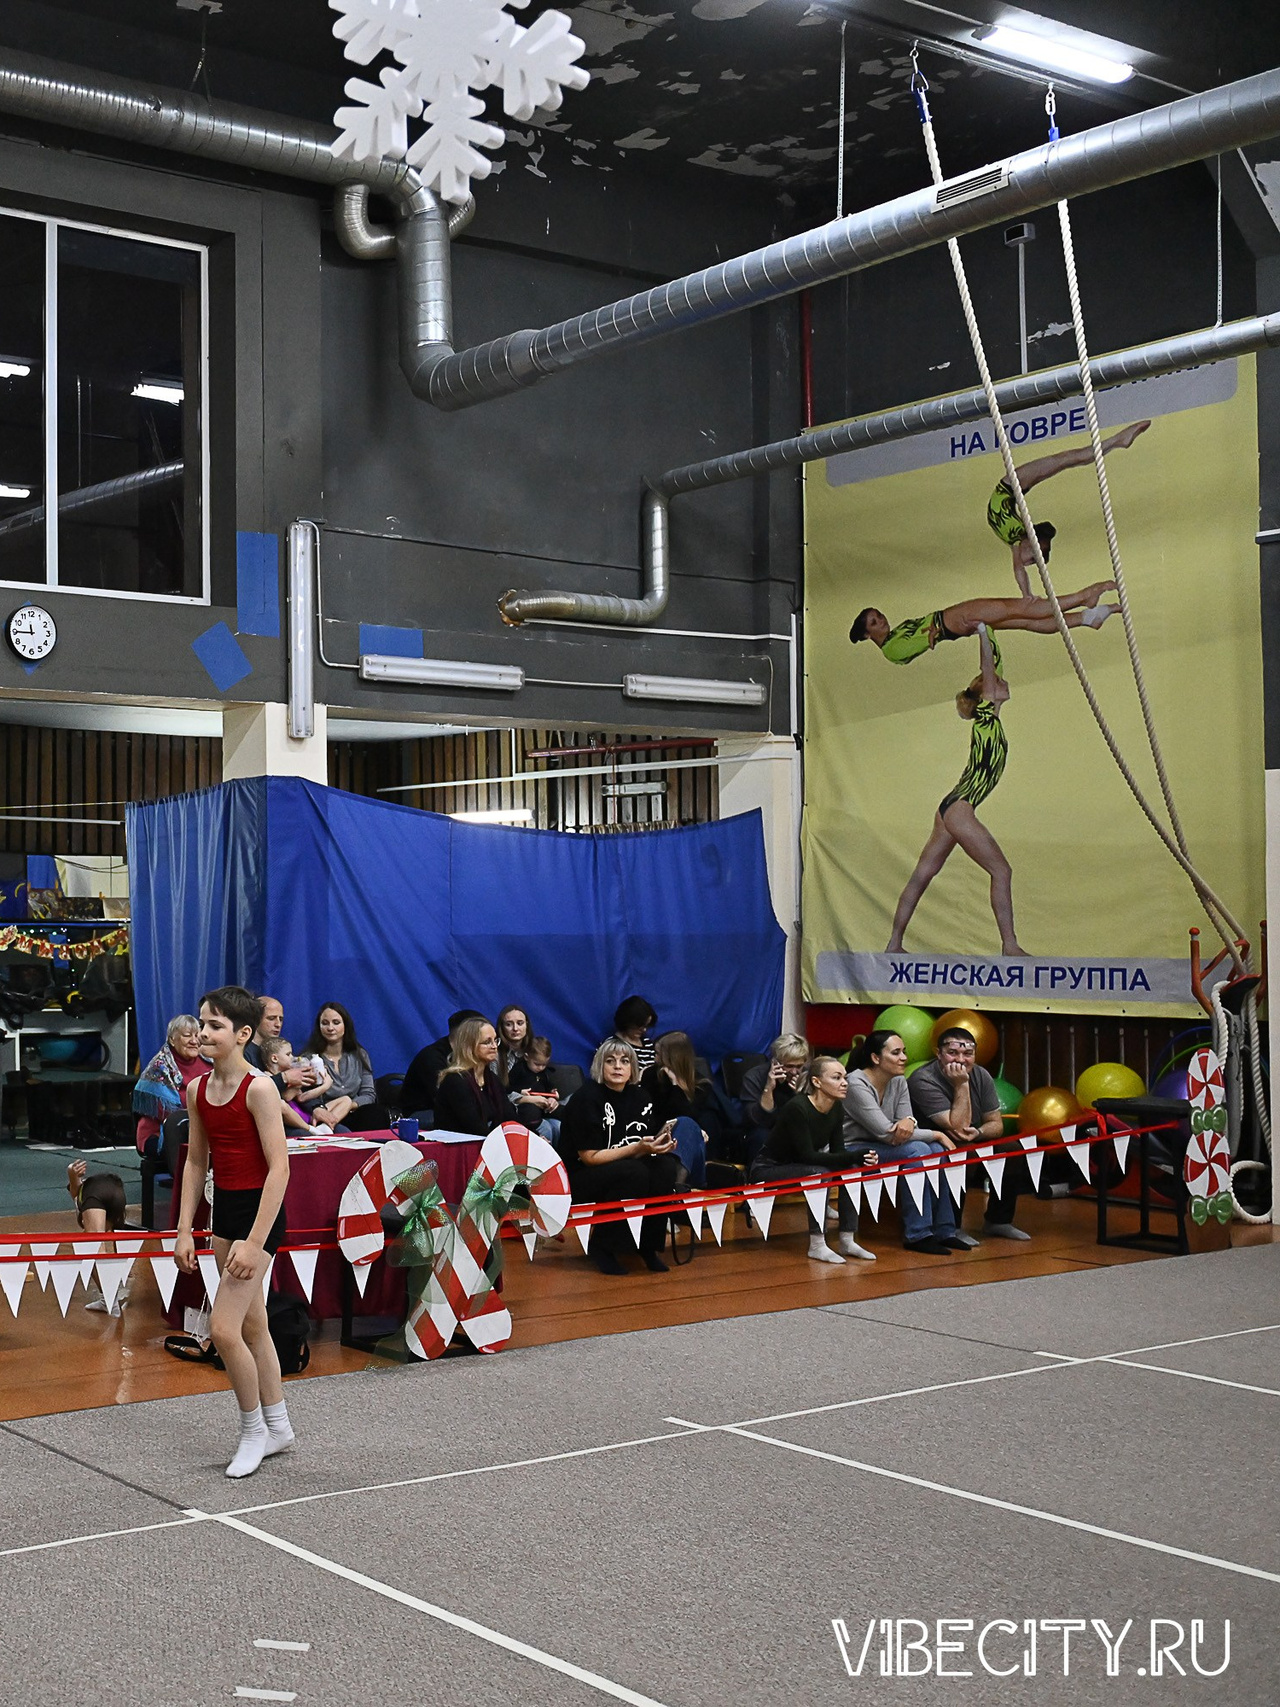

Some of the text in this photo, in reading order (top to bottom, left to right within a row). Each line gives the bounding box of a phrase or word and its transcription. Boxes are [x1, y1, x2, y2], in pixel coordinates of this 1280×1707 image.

[950, 431, 987, 458] НА
[889, 961, 1152, 992] ЖЕНСКАЯ ГРУППА
